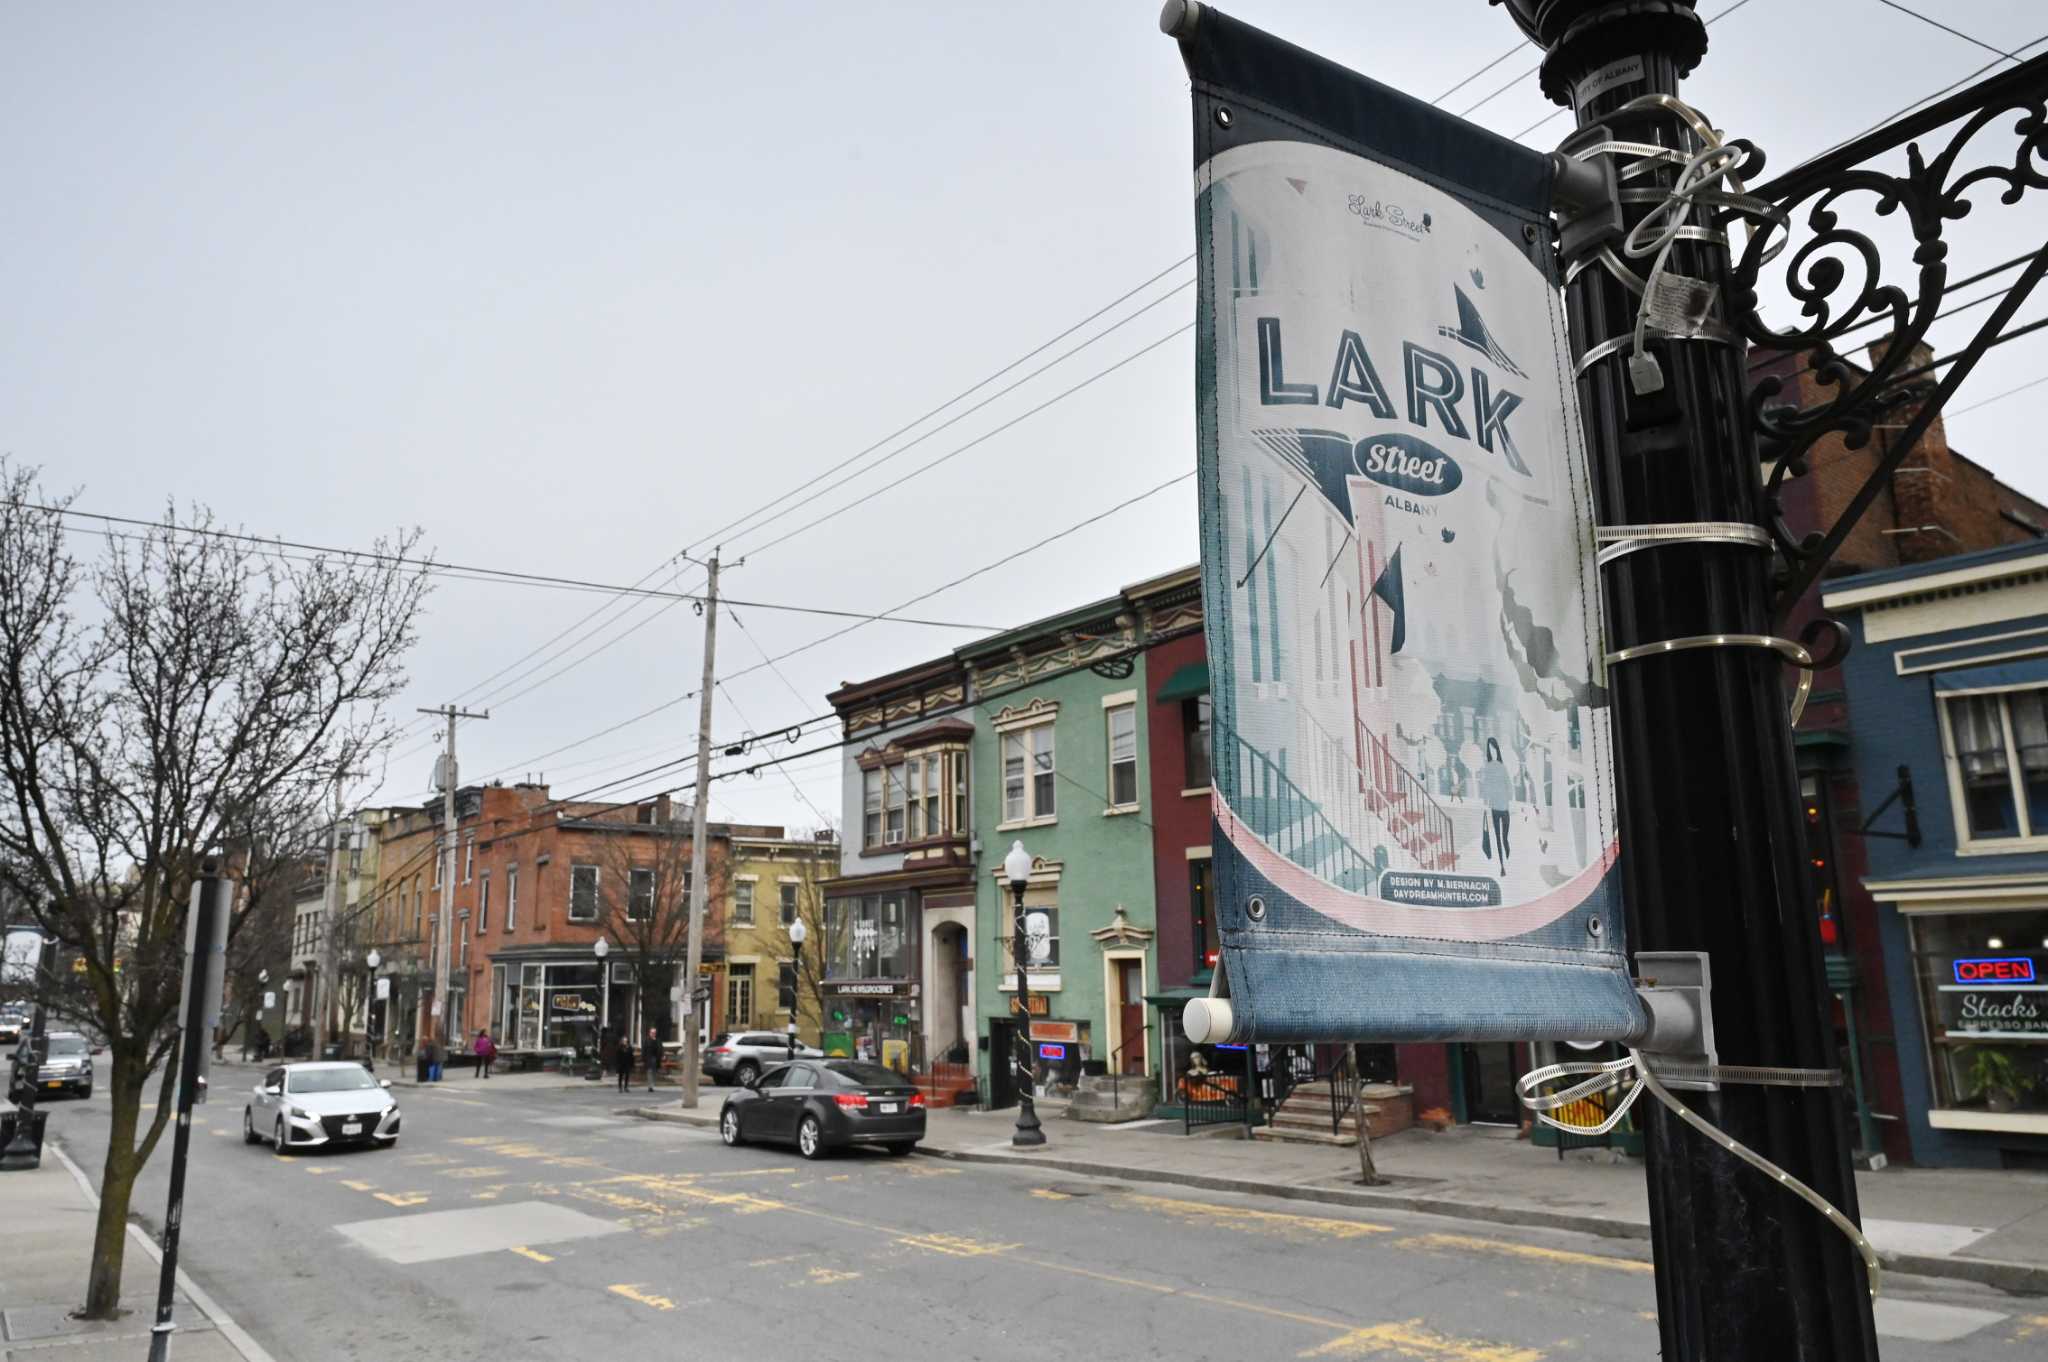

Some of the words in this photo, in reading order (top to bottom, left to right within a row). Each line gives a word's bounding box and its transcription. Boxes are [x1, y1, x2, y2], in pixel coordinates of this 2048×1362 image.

[1592, 77, 1602, 88] OF
[1604, 64, 1640, 80] ALBANY
[1348, 194, 1384, 220] Lark
[1385, 204, 1431, 234] Street
[1257, 317, 1532, 477] LARK
[1366, 443, 1447, 484] Street
[1384, 495, 1438, 516] ALBANY
[1390, 877, 1420, 887] DESIGN
[1423, 879, 1434, 888] BY
[1393, 889, 1489, 902] DAYDREAMHUNTER.COM
[1959, 962, 2030, 980] OPEN
[1961, 993, 2039, 1018] Stacks
